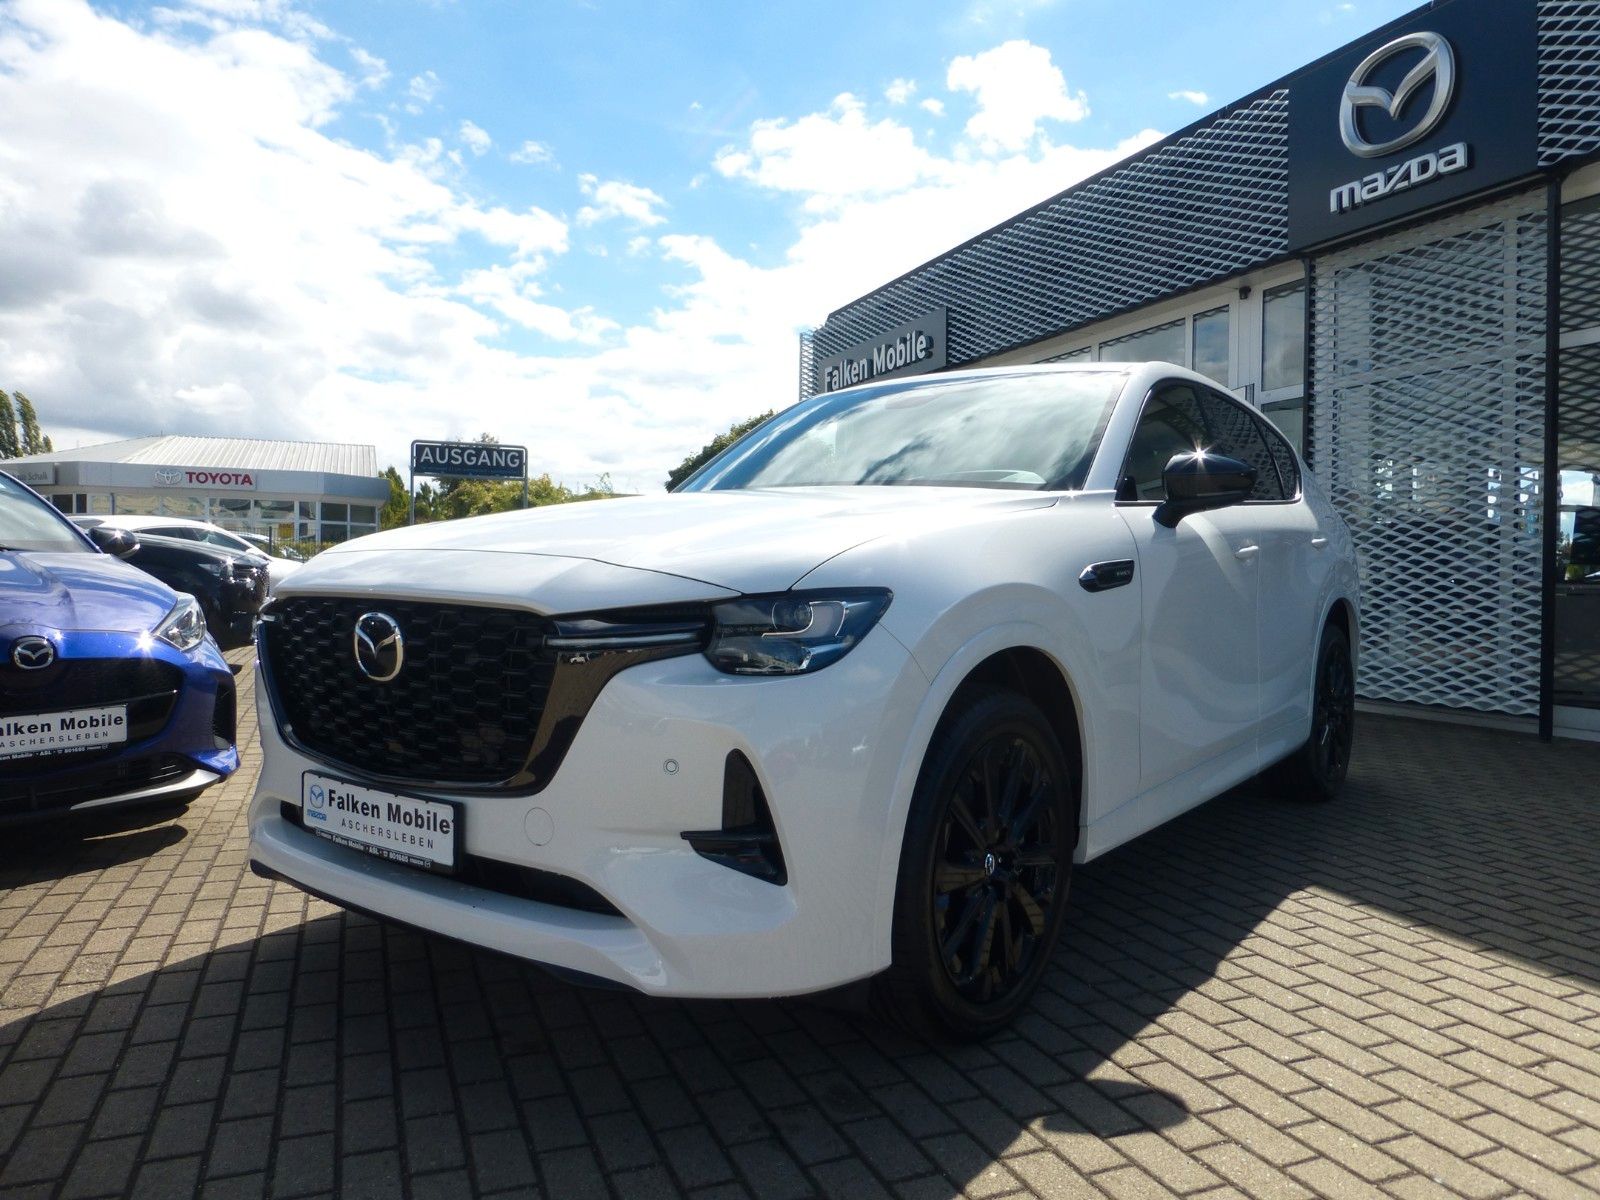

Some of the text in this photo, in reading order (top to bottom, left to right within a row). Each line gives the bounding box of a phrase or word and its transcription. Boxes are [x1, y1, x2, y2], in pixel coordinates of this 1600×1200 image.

[824, 329, 927, 393] Falken Mobile
[420, 446, 520, 468] AUSGANG
[185, 471, 253, 486] TOYOTA
[60, 713, 124, 731] Mobile
[0, 731, 109, 748] ASCHERSLEBEN
[328, 788, 451, 835] Falken Mobile
[341, 818, 434, 849] ASCHERSLEBEN
